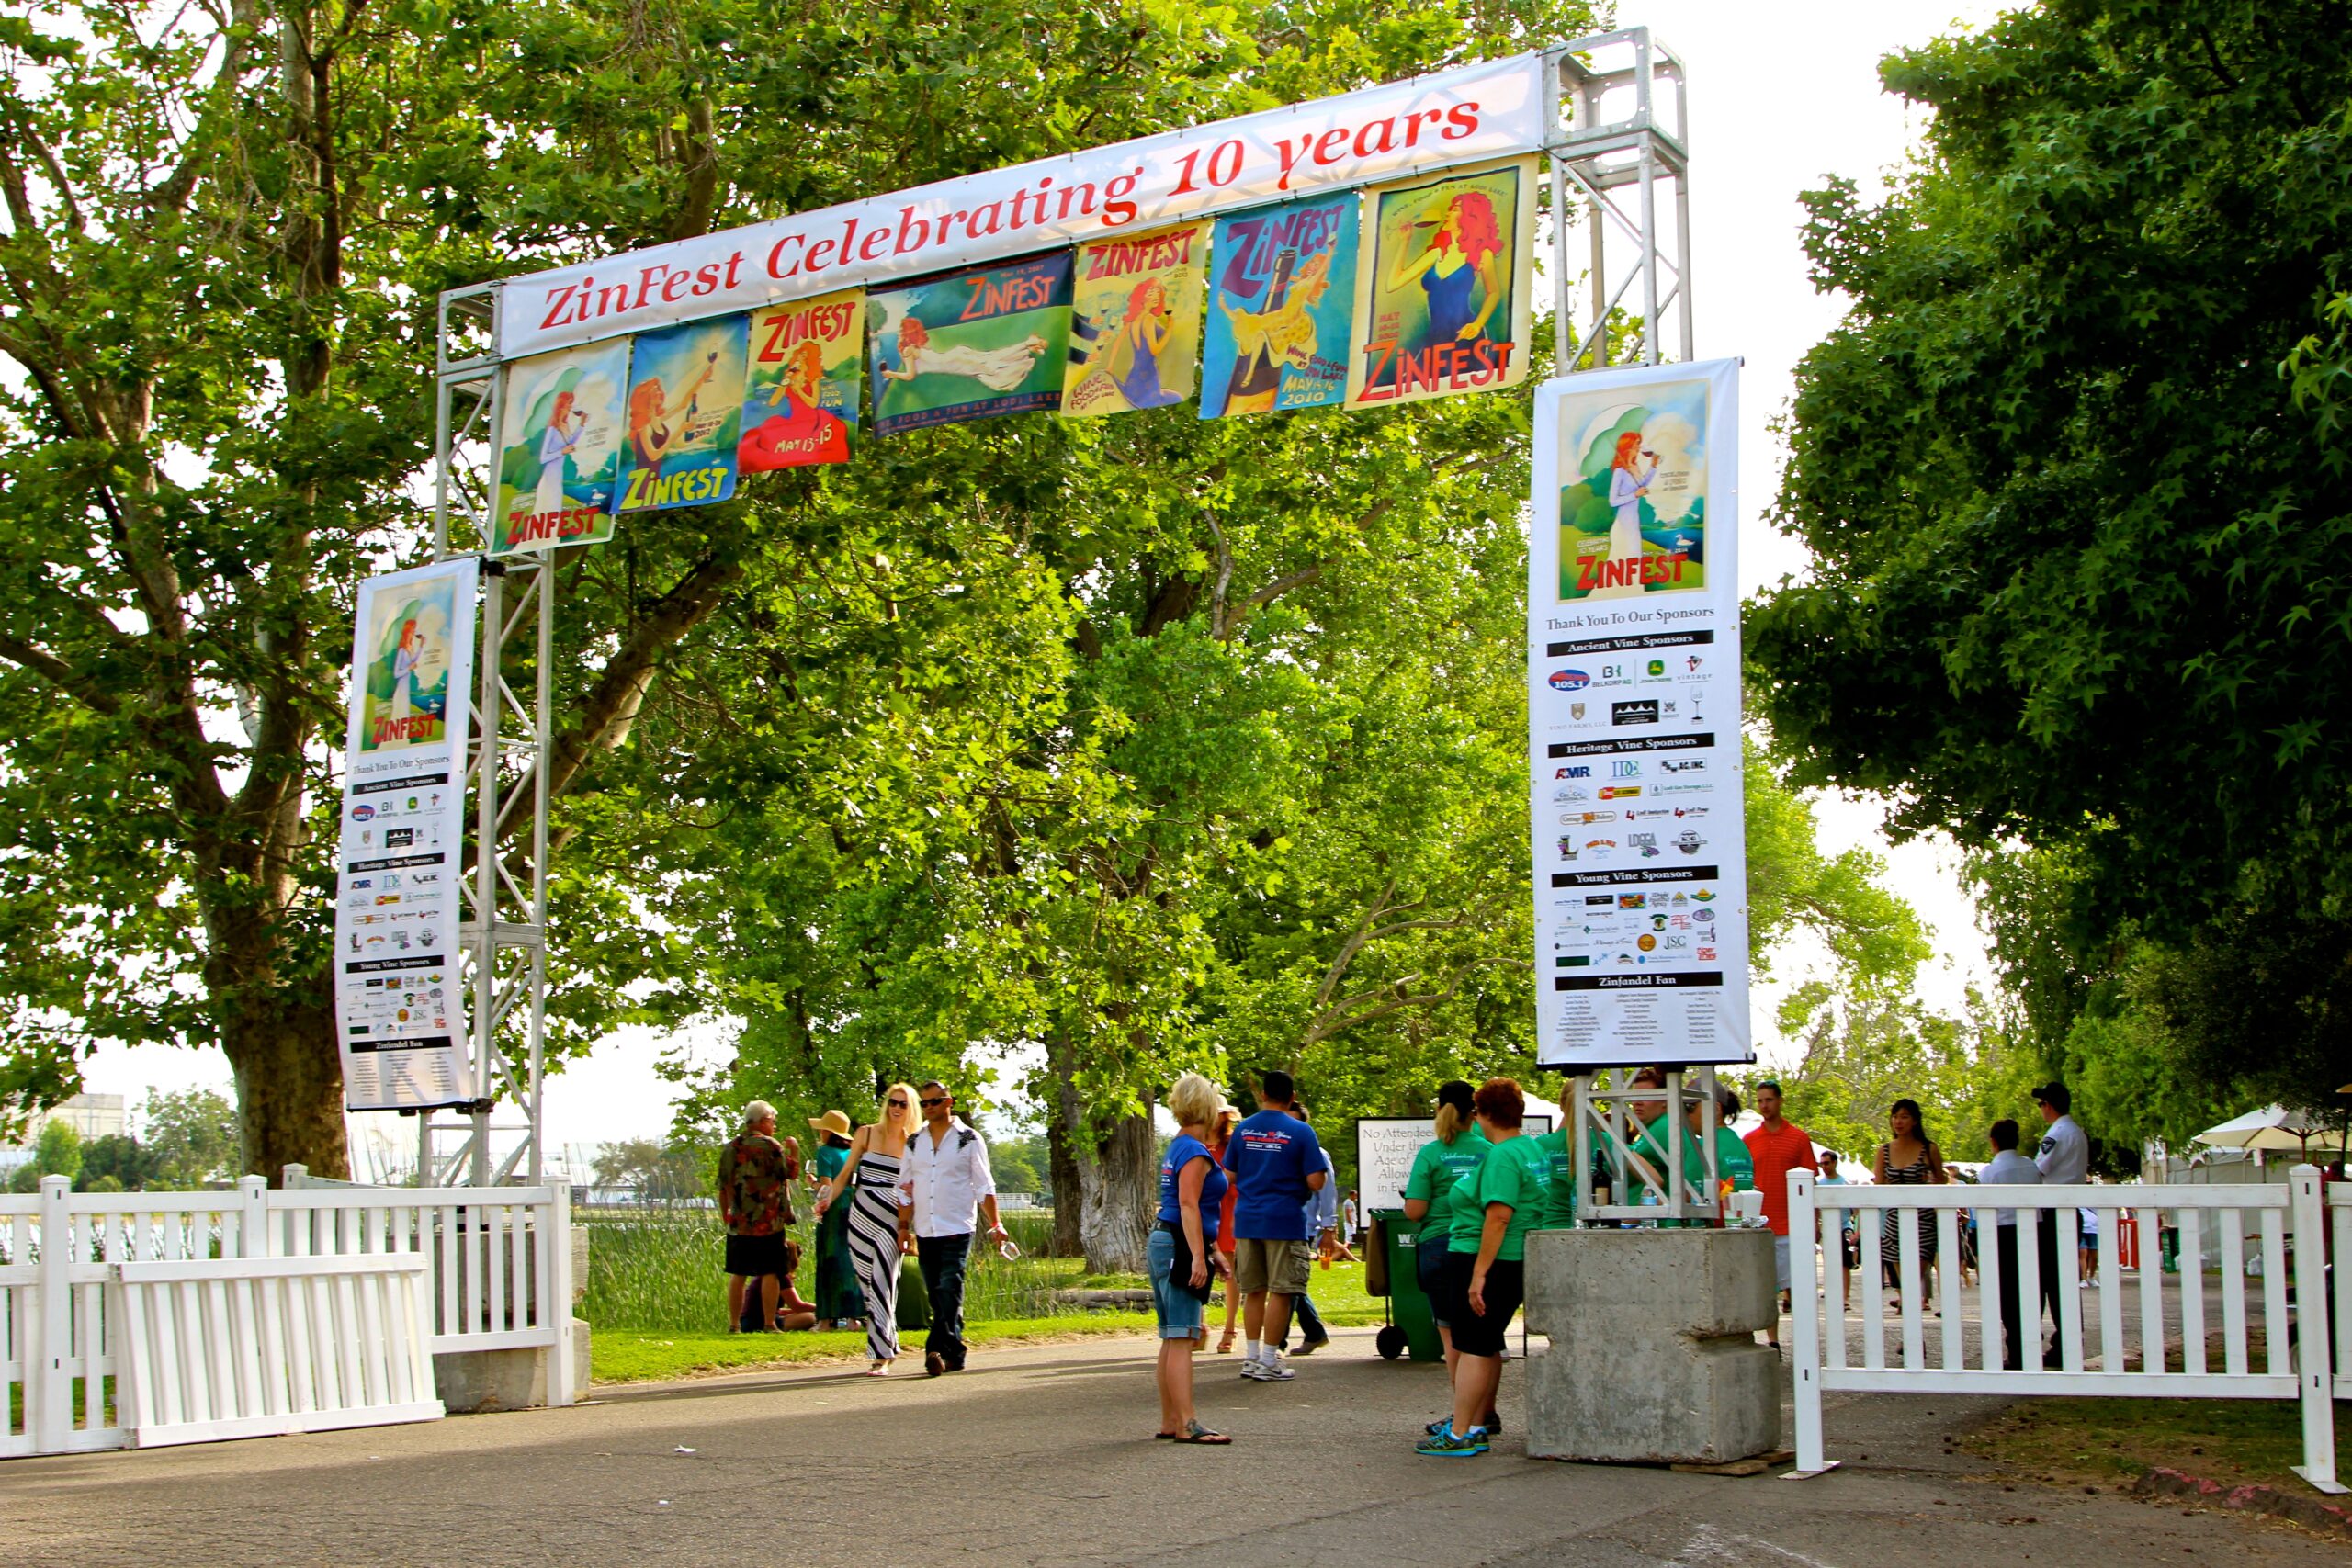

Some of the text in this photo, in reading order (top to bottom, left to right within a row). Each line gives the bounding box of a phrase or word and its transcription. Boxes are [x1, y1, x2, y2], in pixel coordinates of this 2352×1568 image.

[538, 100, 1481, 331] ZinFest Celebrating 10 years
[1086, 228, 1198, 281] ZINFEST
[757, 301, 856, 363] ZINFEST
[1282, 374, 1314, 393] MAY
[974, 400, 989, 411] AT
[994, 398, 1023, 408] LODI
[1282, 391, 1326, 406] 2010
[775, 423, 833, 453] MAY 13-15
[505, 507, 600, 545] ZINFEST
[1576, 553, 1689, 591] ZINFEST
[1546, 608, 1715, 630] Thank You To Our Sponsors
[1567, 636, 1695, 653] Ancient Vine Sponsors
[1554, 680, 1585, 689] 105.1
[1677, 673, 1713, 682] vintage
[371, 714, 436, 744] ZINFEST
[1566, 736, 1697, 755] Heritage Vine Sponsors
[353, 765, 375, 775] Thank
[375, 763, 389, 773] You
[399, 760, 413, 769] Our
[415, 755, 450, 770] Sponsors
[1575, 869, 1693, 884] Young Vine Sponsors
[1663, 936, 1687, 950] JSC
[1599, 976, 1677, 987] Zinfandel Fan
[1363, 1126, 1435, 1139] No Attendee
[1374, 1141, 1406, 1152] Under
[1374, 1152, 1411, 1166] Age of
[1378, 1182, 1387, 1192] in
